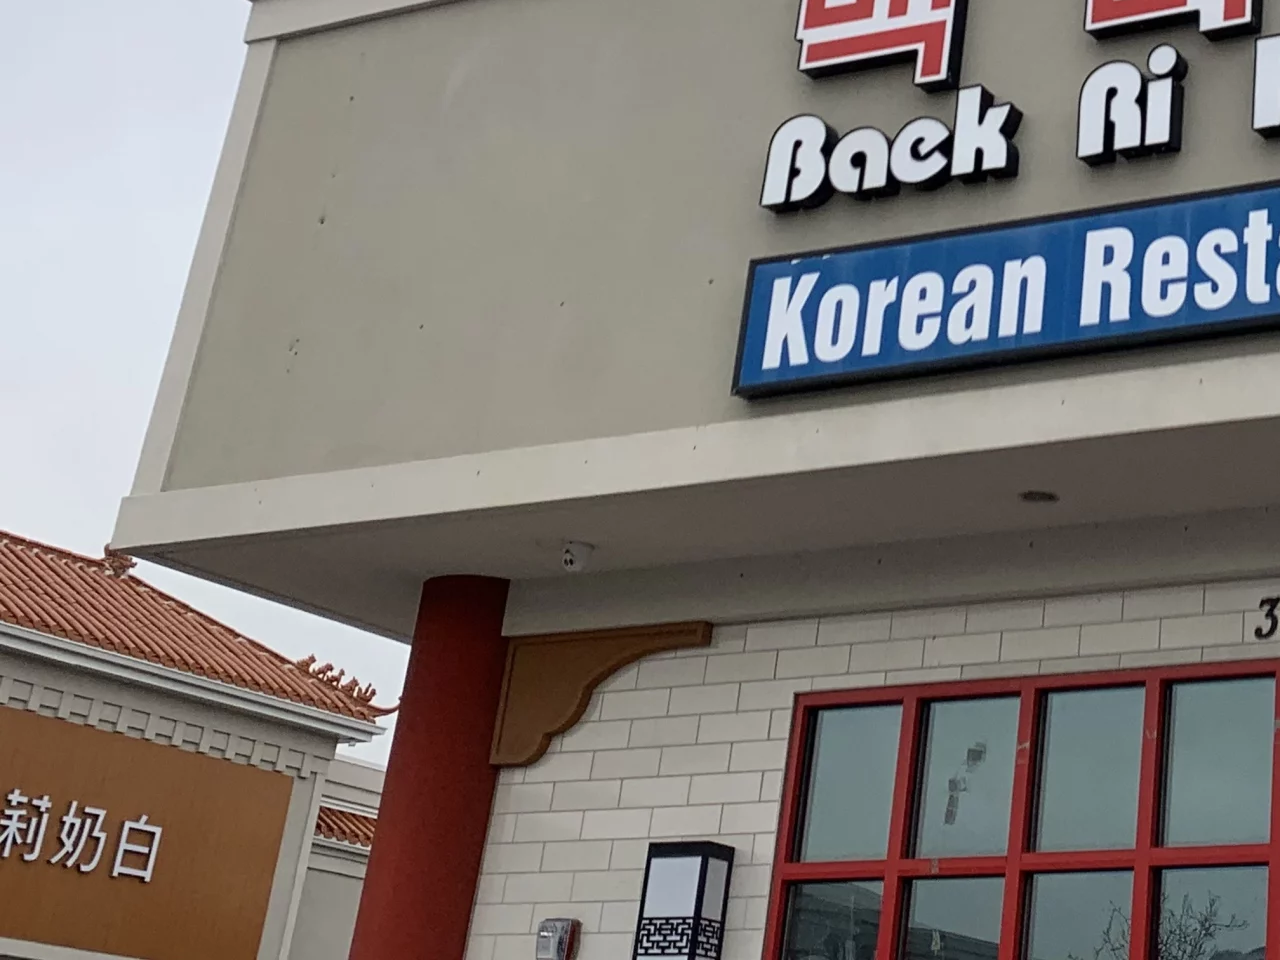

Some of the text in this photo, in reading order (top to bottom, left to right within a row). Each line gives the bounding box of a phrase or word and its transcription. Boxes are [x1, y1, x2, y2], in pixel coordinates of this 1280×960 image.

[761, 85, 1010, 206] Baek
[1077, 44, 1178, 158] Ri
[761, 255, 1046, 370] Korean
[0, 789, 162, 882] 莉奶白
